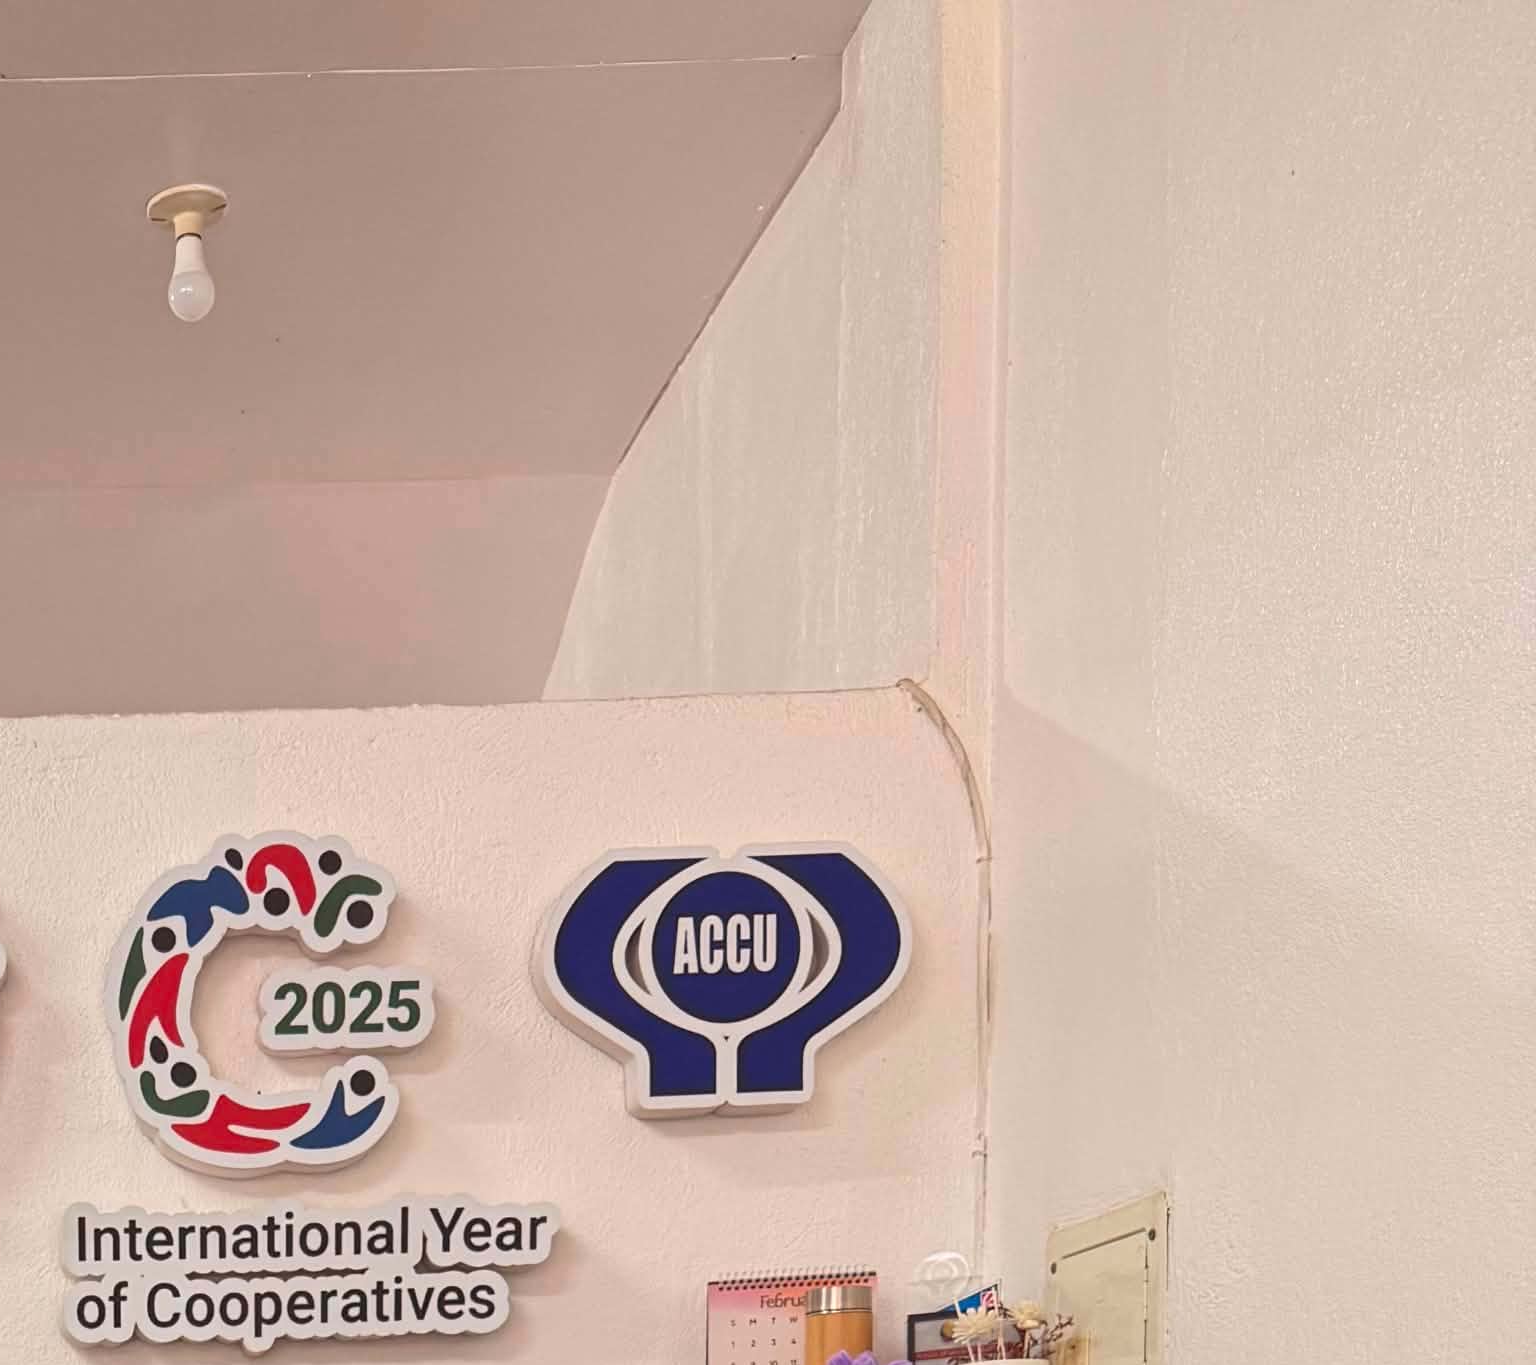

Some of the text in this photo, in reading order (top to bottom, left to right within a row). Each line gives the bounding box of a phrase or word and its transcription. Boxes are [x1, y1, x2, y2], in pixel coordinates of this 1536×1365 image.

[673, 913, 777, 975] ACCU
[274, 980, 421, 1035] 2025
[77, 1206, 548, 1262] International Year
[76, 1278, 495, 1338] of Cooperatives
